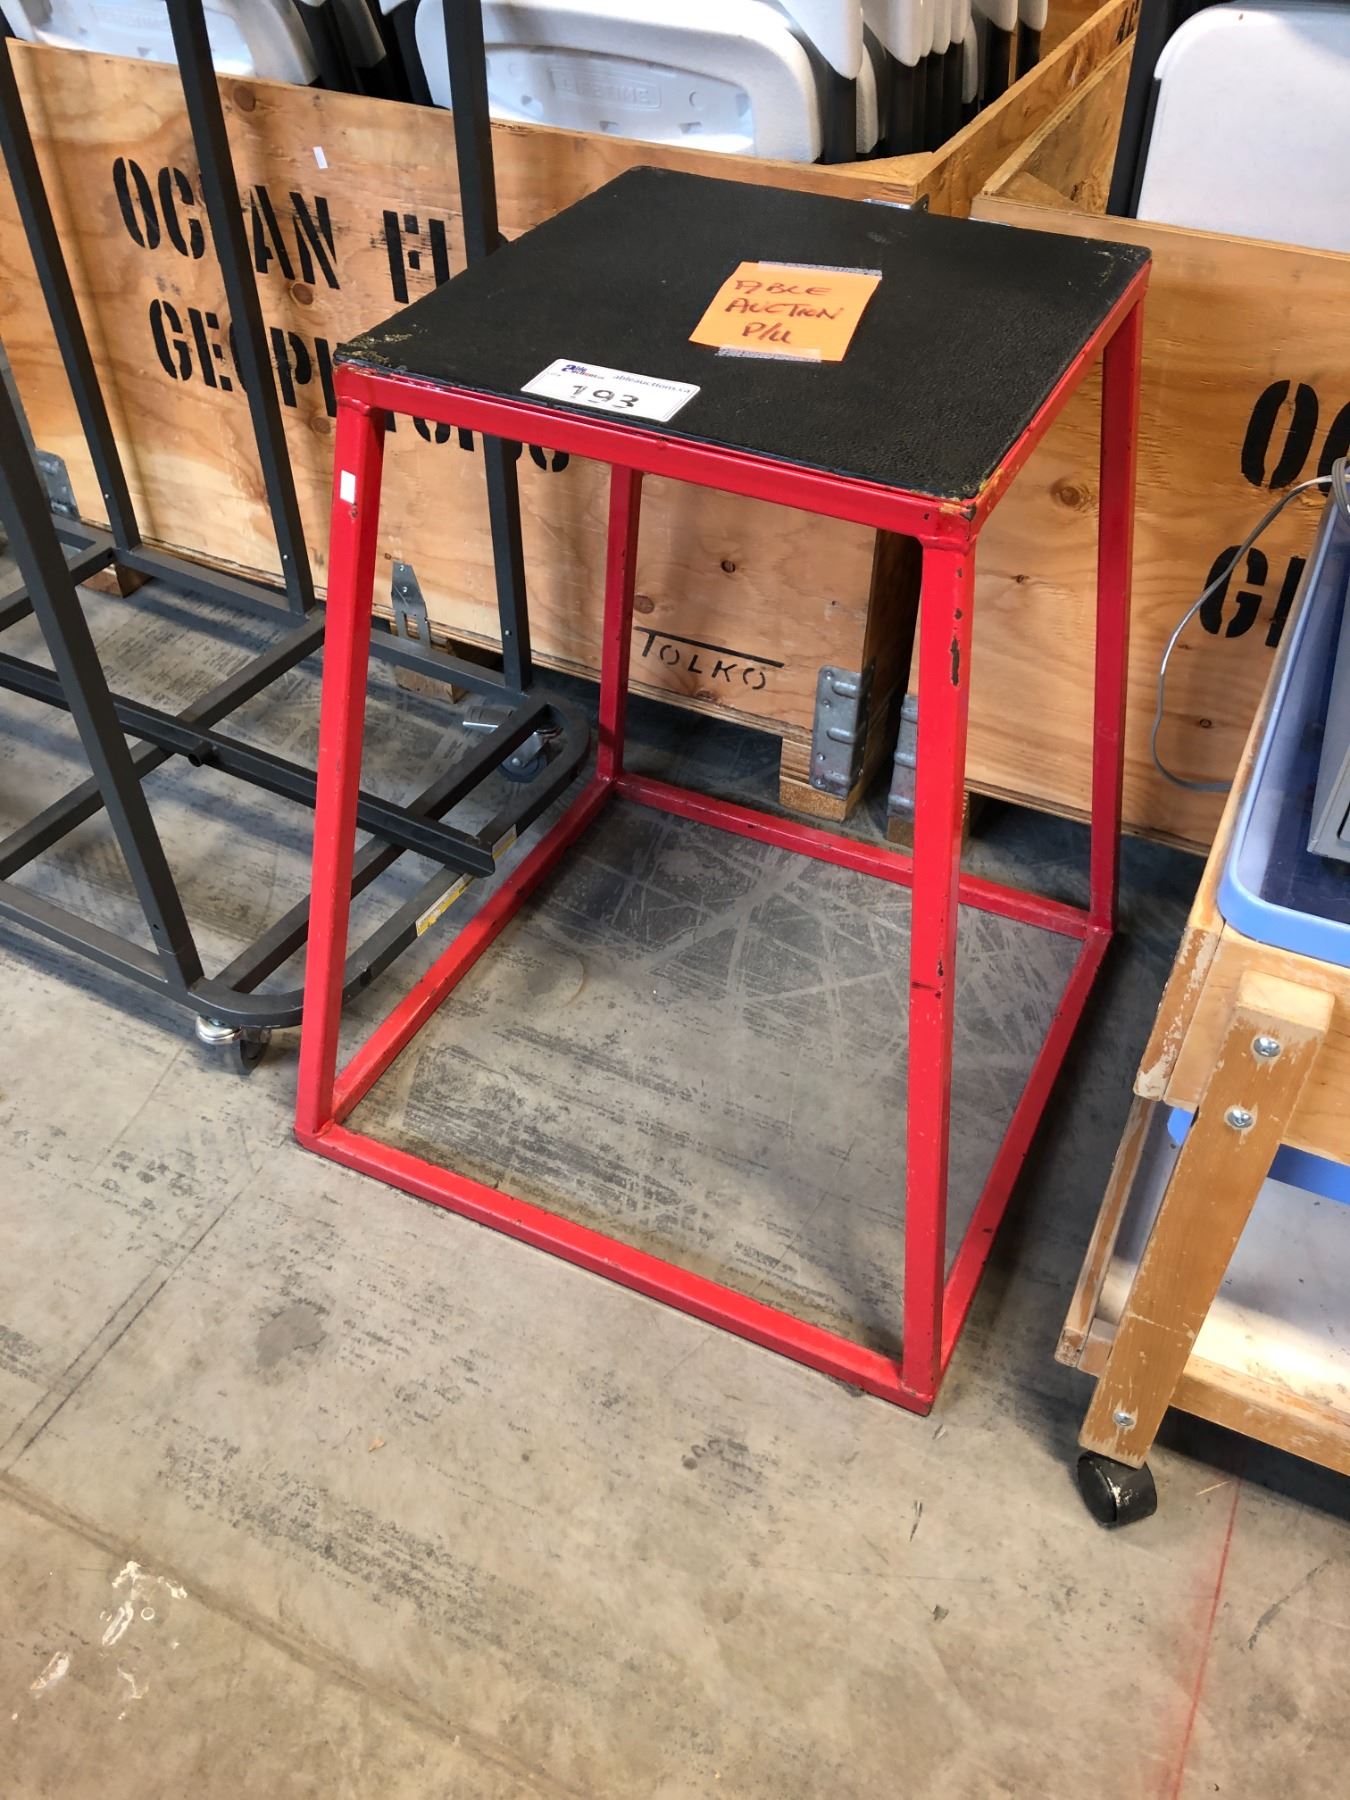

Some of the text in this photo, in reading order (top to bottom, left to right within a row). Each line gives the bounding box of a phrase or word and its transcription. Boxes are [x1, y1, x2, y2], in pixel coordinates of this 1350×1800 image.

[112, 156, 341, 290] OCAN
[569, 384, 640, 409] 193
[633, 625, 785, 690] TOLKO
